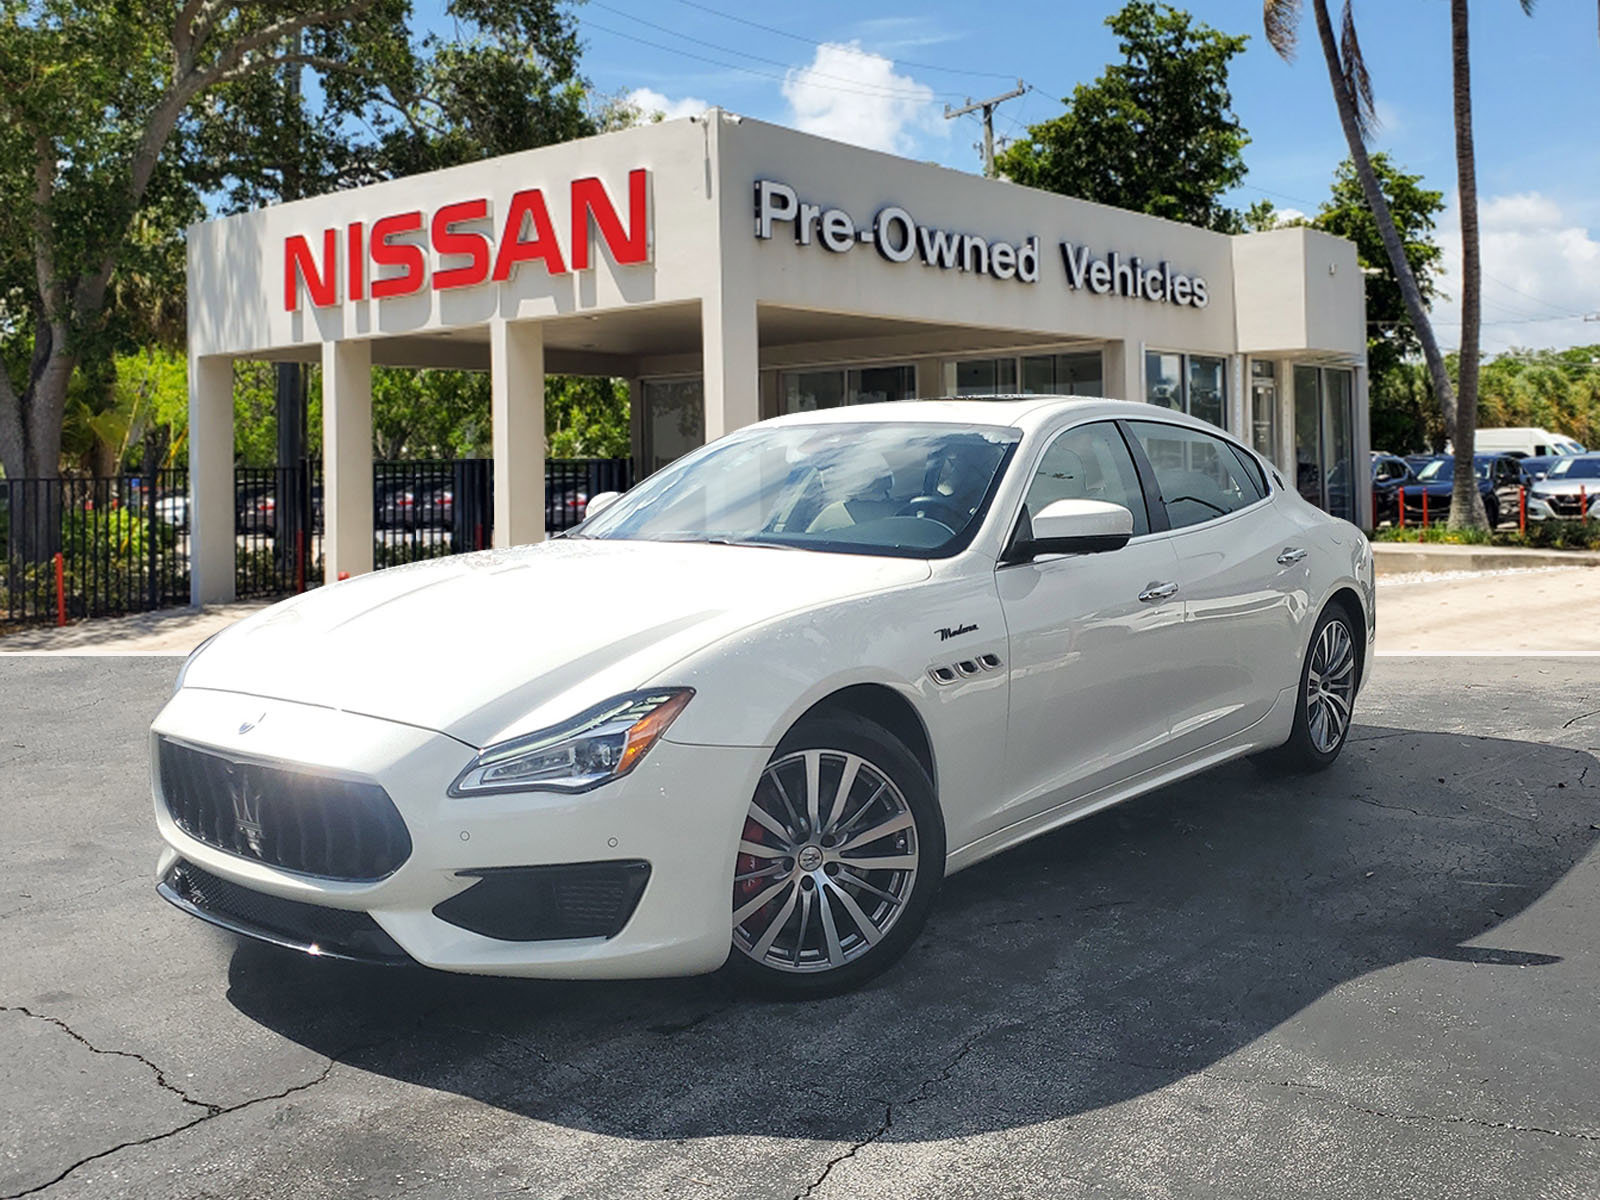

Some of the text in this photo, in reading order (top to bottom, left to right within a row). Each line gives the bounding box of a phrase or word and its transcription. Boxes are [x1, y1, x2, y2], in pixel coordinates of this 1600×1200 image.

[284, 168, 650, 312] NISSAN
[754, 180, 1209, 308] Pre-Owned Vehicles
